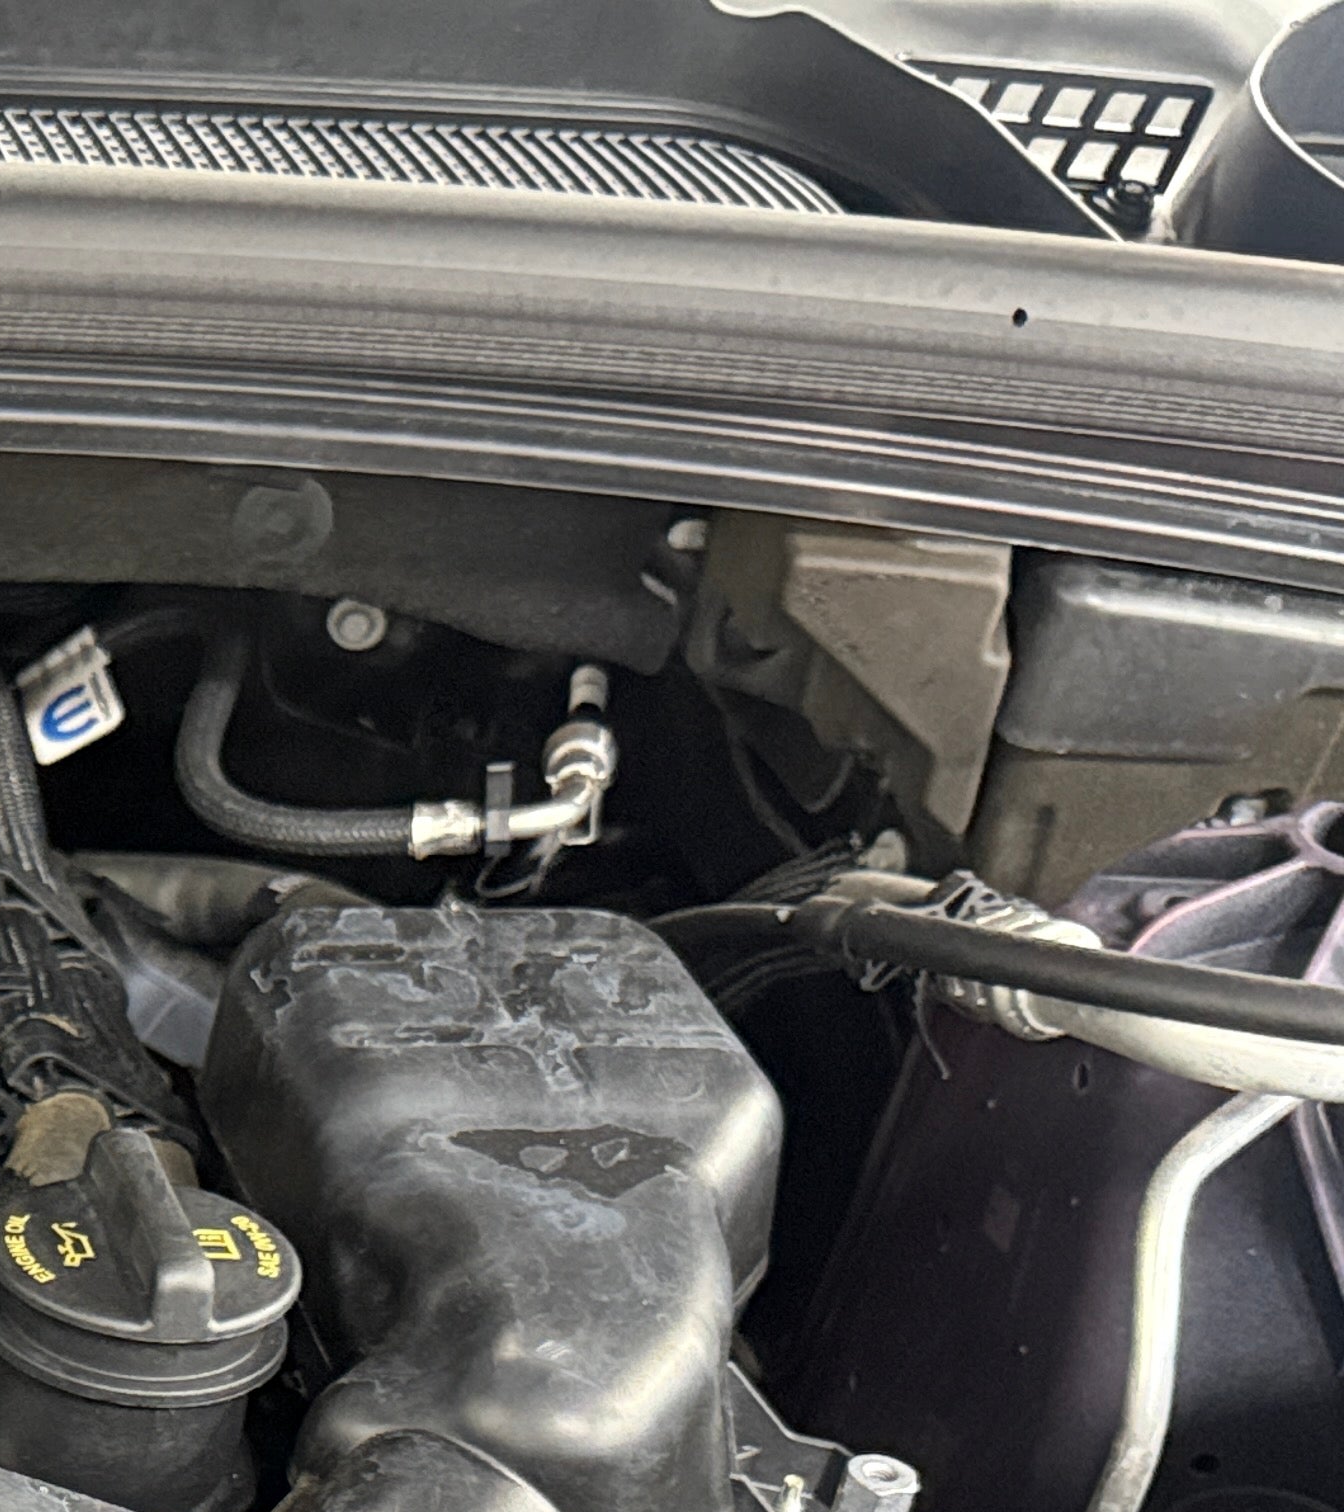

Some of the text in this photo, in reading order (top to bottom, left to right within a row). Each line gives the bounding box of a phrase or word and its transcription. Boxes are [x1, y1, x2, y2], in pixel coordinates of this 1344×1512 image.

[4, 1213, 57, 1284] ENGINE OIL
[256, 1250, 281, 1279] SAE
